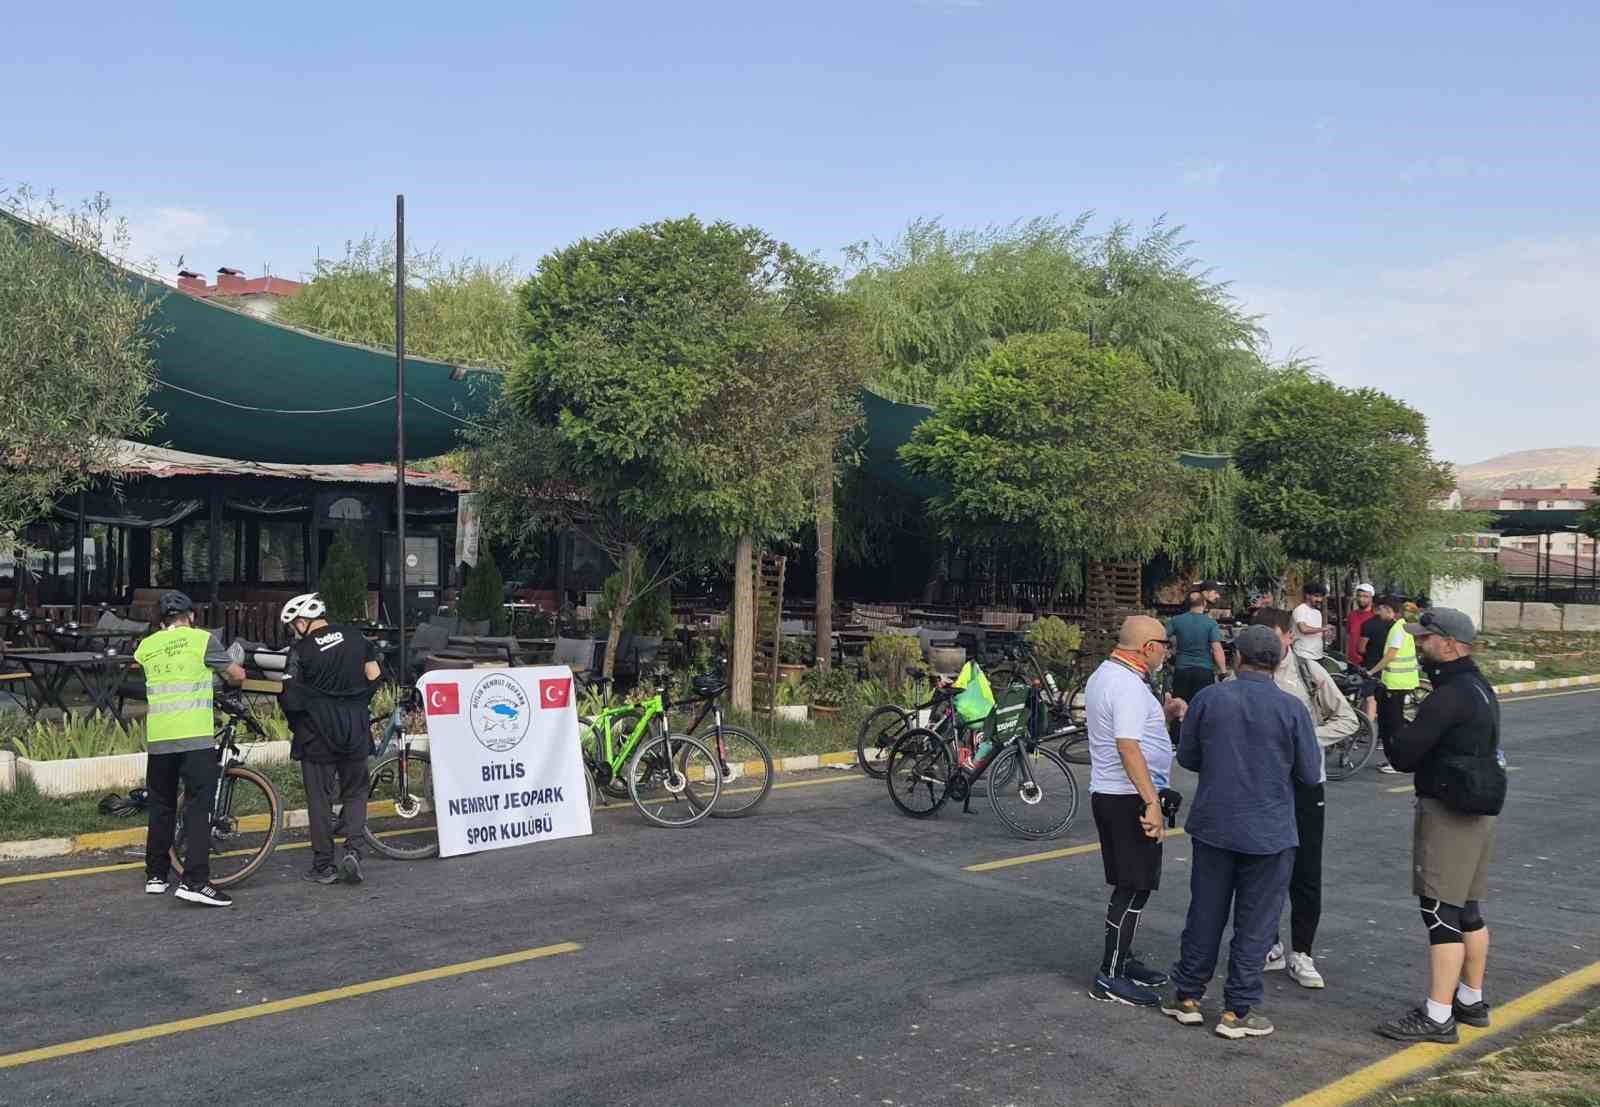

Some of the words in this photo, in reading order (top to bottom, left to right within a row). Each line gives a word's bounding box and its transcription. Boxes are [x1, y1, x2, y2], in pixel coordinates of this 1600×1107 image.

[314, 631, 344, 646] beko
[481, 759, 525, 782] BİTLİS
[448, 794, 500, 816] NEMRUT
[503, 786, 564, 810] JEOPARK
[467, 825, 497, 845] SPOR
[500, 812, 553, 839] KULÜBÜ
